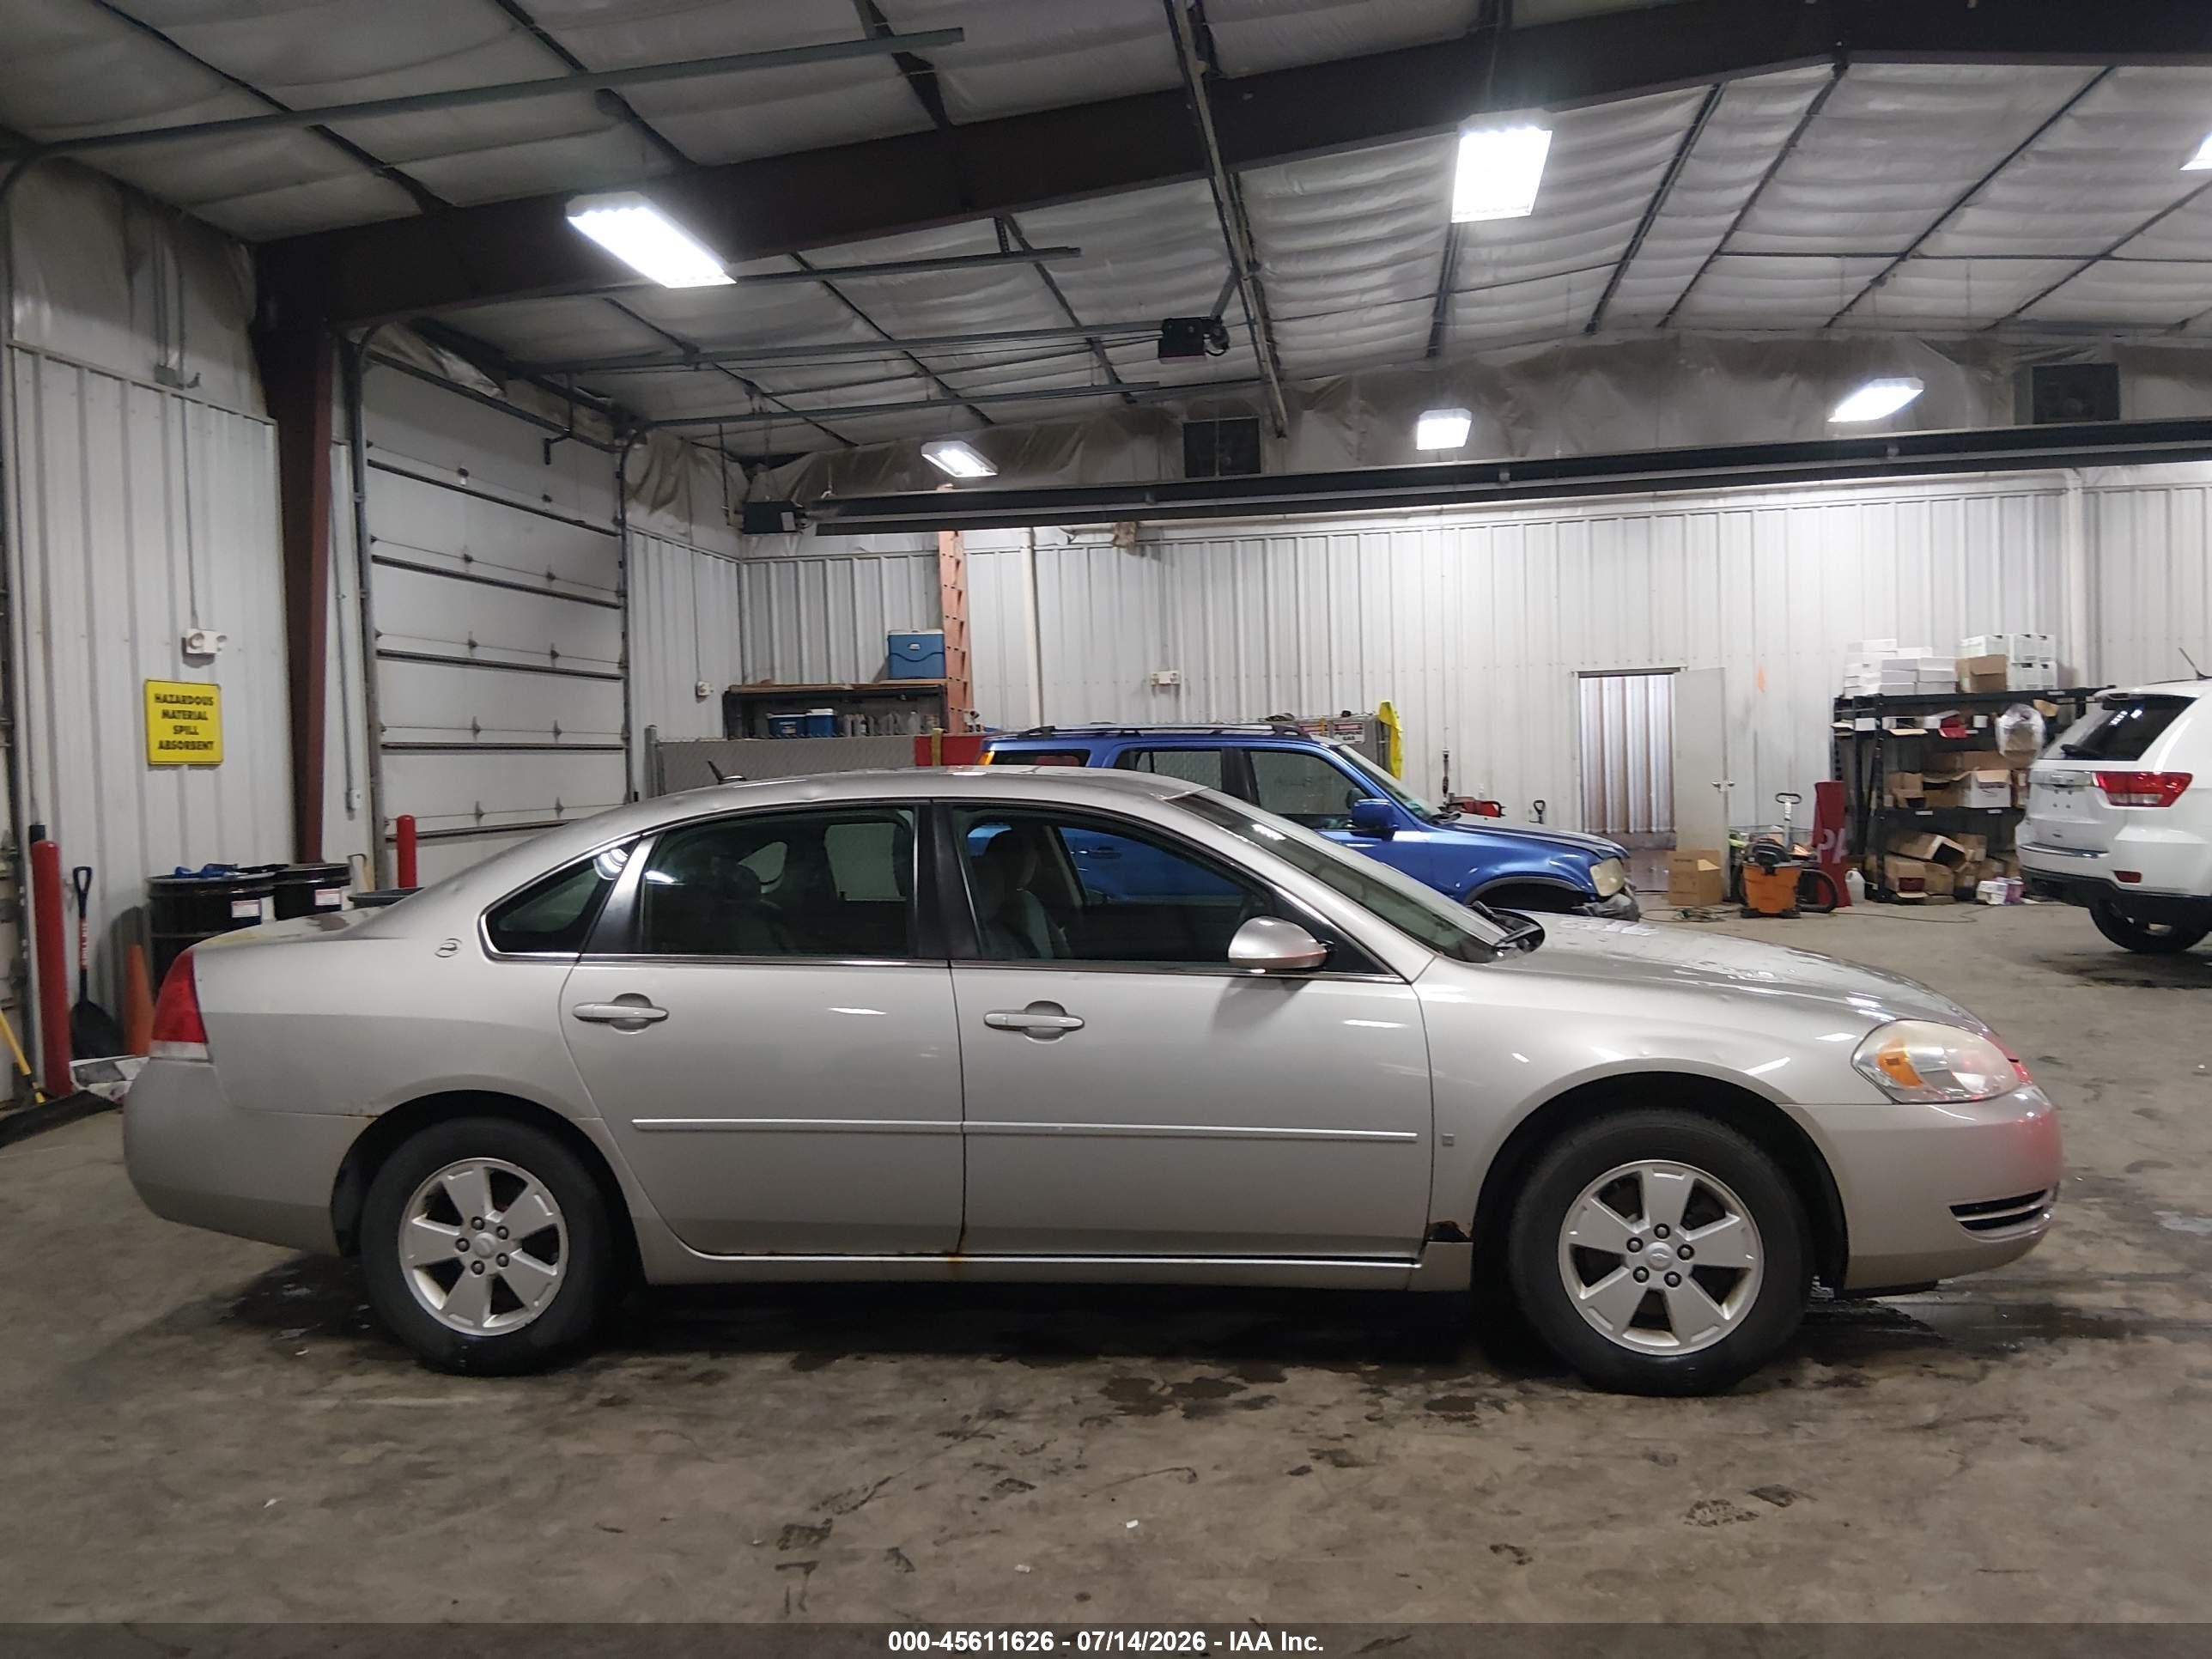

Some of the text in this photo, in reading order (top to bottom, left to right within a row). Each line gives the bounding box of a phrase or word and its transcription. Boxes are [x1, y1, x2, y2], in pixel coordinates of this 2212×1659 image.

[154, 693, 214, 706] HAZARDOUS
[161, 709, 209, 720] MATERIAL
[173, 725, 199, 736] SPILL
[158, 740, 214, 750] ABSORBENT
